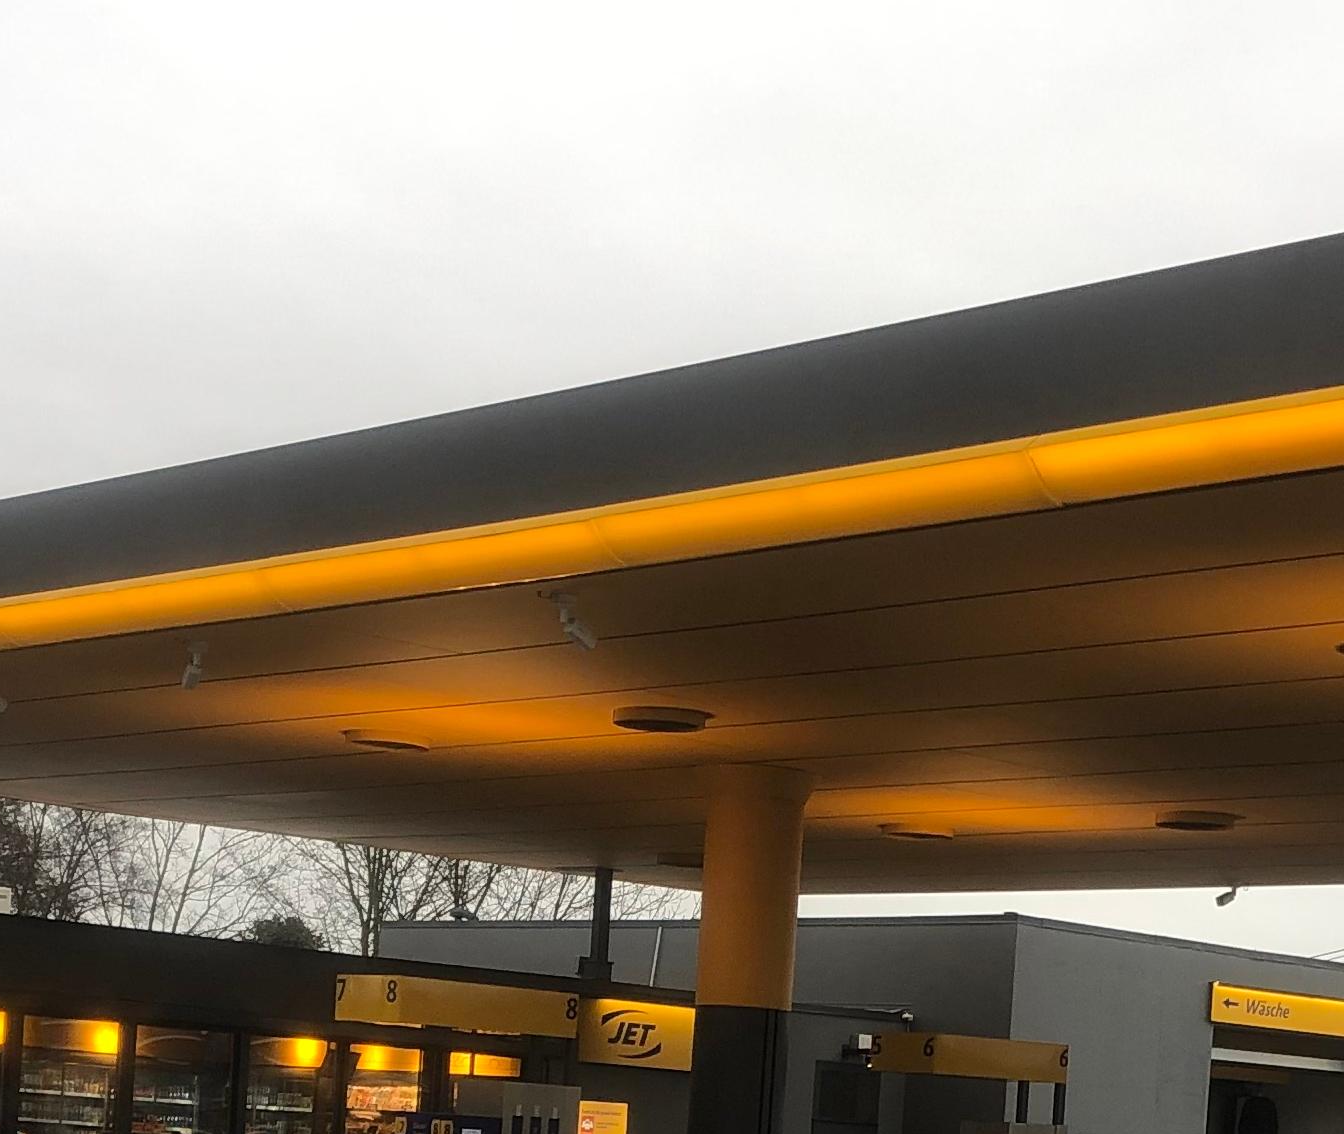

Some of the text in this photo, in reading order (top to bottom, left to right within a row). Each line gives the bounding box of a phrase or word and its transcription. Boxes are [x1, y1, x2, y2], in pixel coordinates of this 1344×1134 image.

[336, 978, 347, 1002] 7
[386, 979, 398, 1003] 8
[565, 997, 578, 1021] 8
[1245, 998, 1291, 1020] Wäsche
[606, 1022, 657, 1048] JET
[871, 1035, 882, 1055] 5
[922, 1036, 935, 1057] 6
[1059, 1048, 1069, 1068] 6
